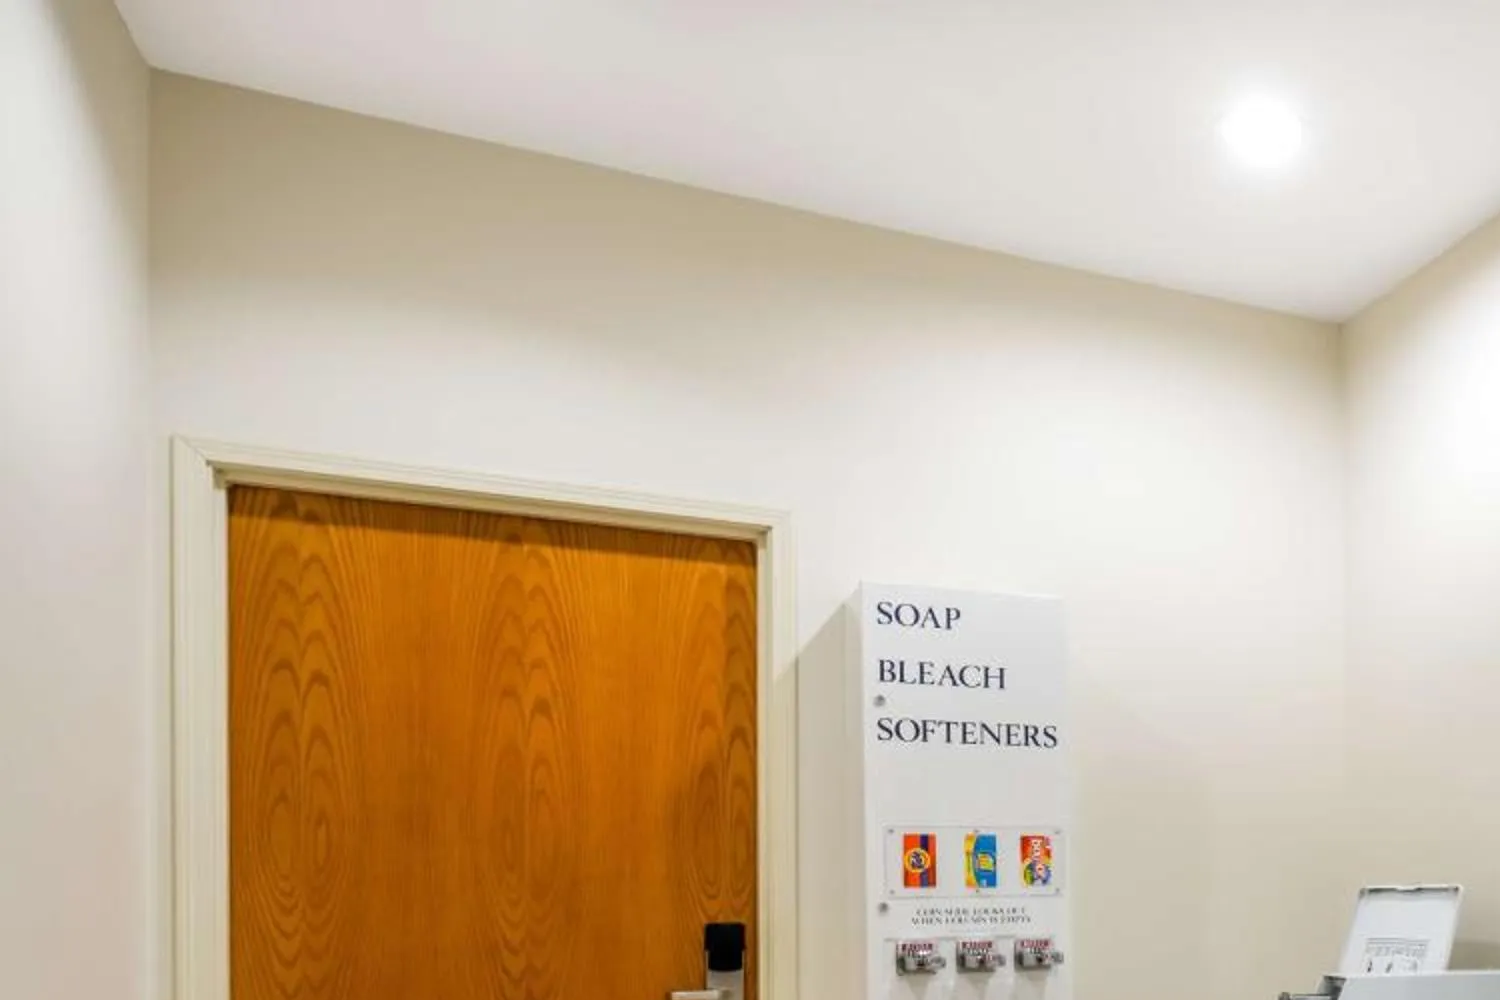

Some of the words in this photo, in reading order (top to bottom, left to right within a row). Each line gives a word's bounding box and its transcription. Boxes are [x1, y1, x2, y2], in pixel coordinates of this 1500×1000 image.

[877, 601, 961, 630] SOAP
[878, 659, 1008, 690] BLEACH
[877, 717, 1058, 749] SOFTENERS
